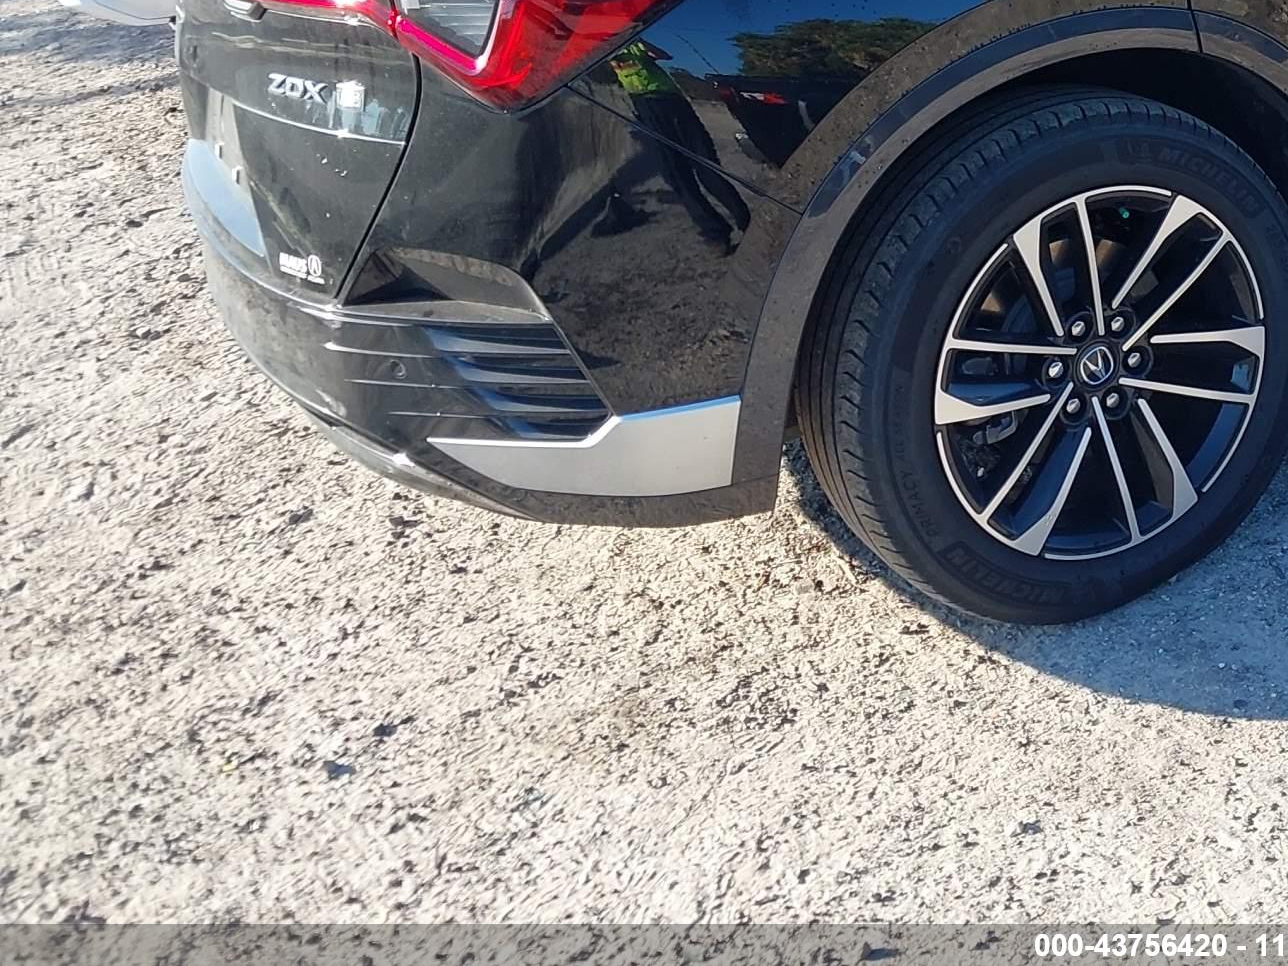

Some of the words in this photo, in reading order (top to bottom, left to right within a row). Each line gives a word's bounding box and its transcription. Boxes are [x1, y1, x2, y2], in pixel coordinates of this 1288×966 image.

[267, 72, 329, 105] ZDX
[1160, 145, 1261, 209] MICHELIN
[899, 469, 938, 537] PRIMACY
